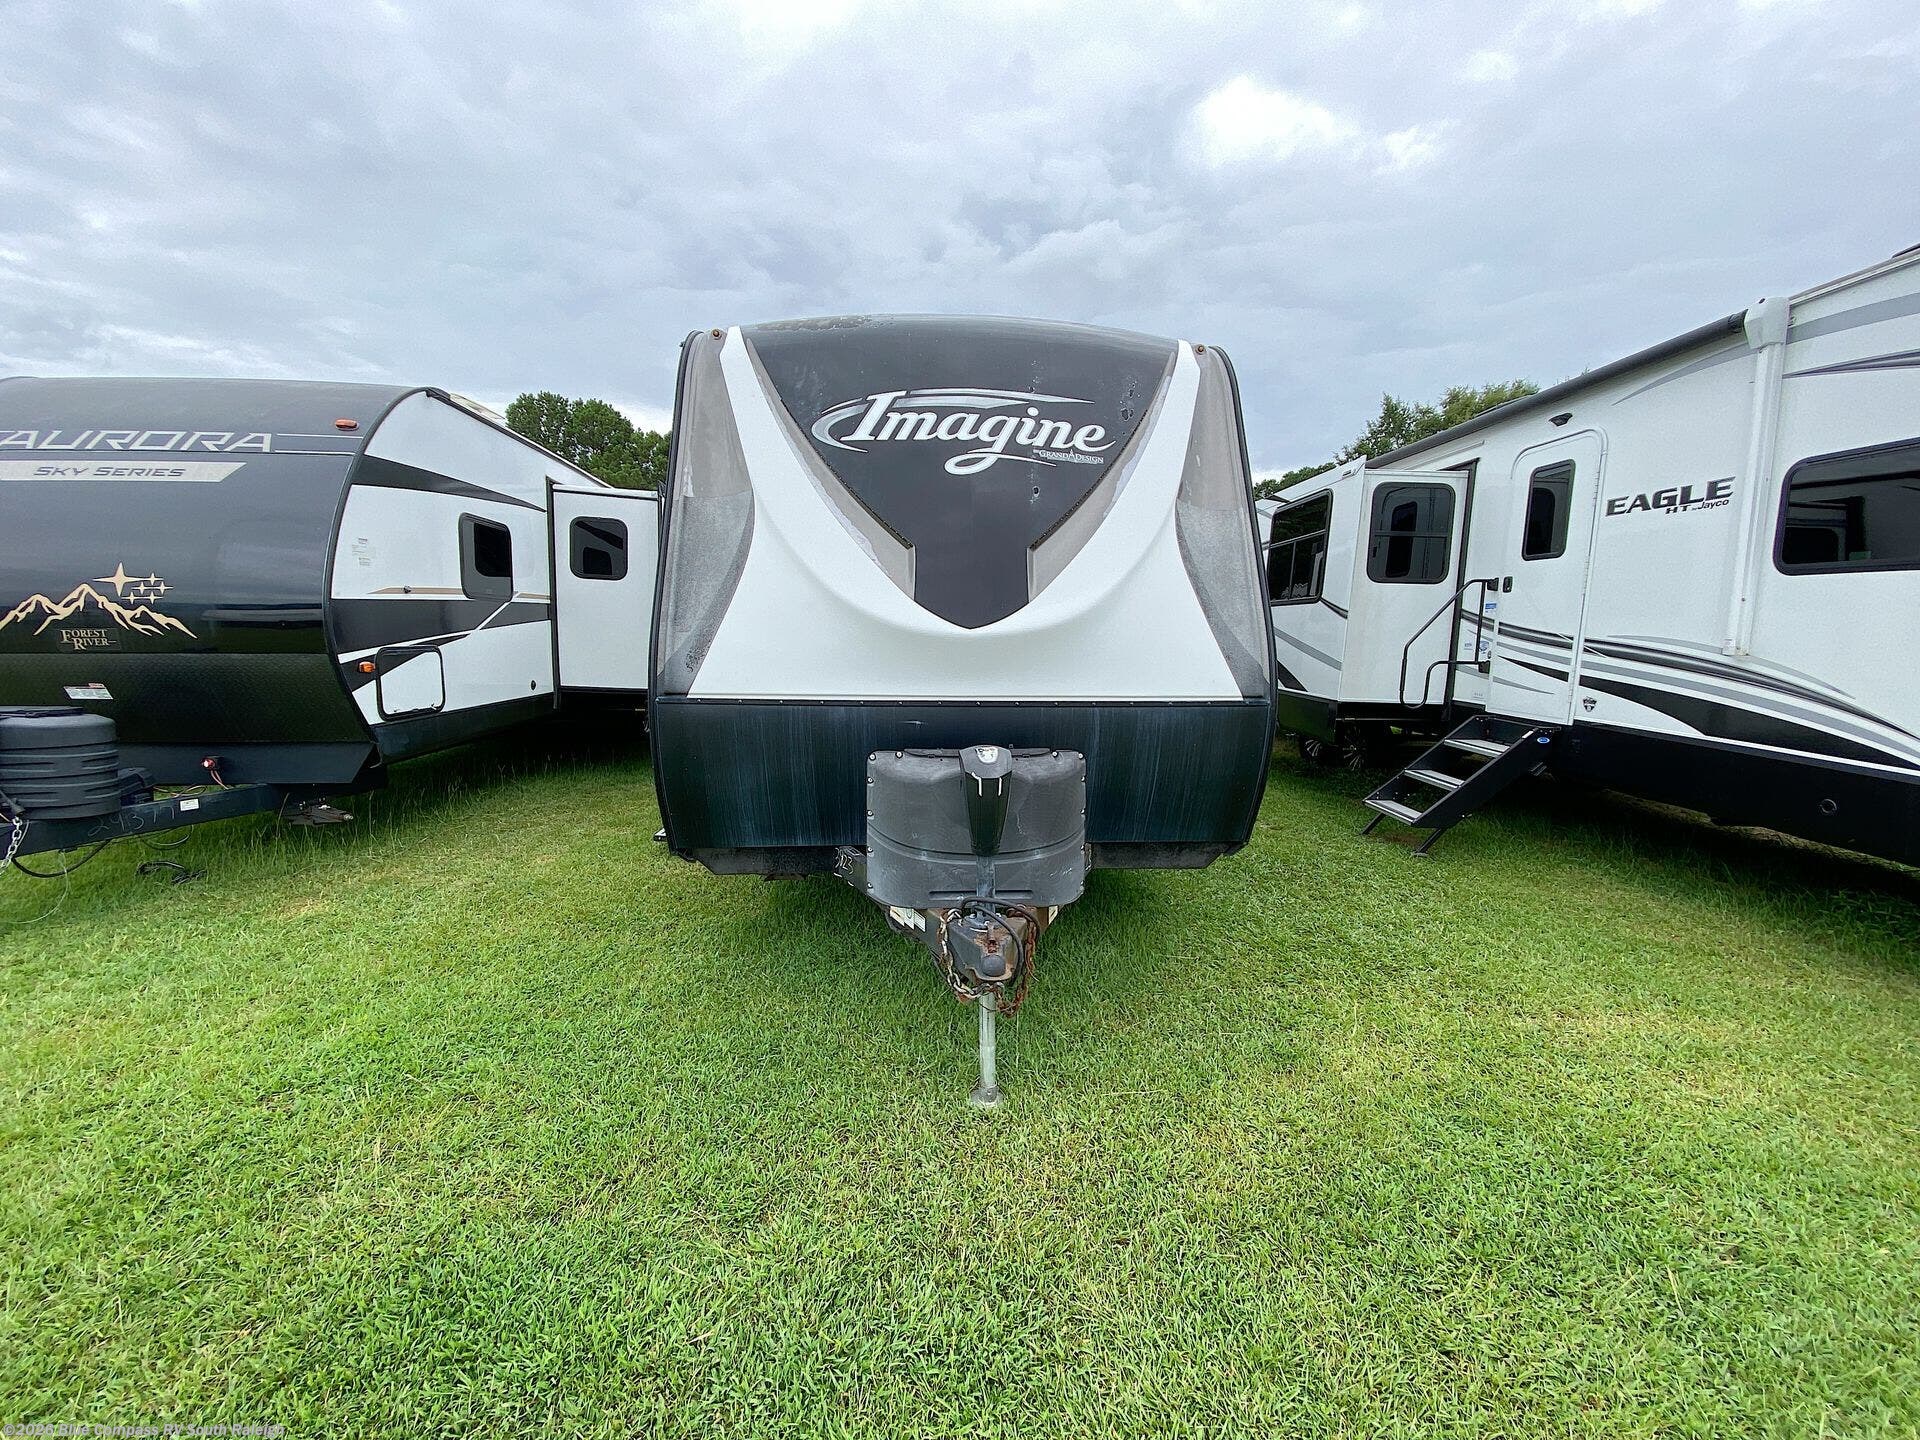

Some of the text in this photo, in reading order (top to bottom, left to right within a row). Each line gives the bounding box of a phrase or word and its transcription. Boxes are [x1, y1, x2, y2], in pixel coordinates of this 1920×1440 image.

[839, 390, 1117, 475] Imagine
[0, 430, 272, 452] AURORA
[1039, 449, 1070, 460] GRAND
[1075, 453, 1104, 464] DESIGN
[34, 466, 186, 478] SKY SERIES
[1605, 476, 1736, 517] EAGLE
[1698, 499, 1730, 510] Jayco
[60, 629, 108, 643] FOREST
[71, 637, 110, 650] RIVER
